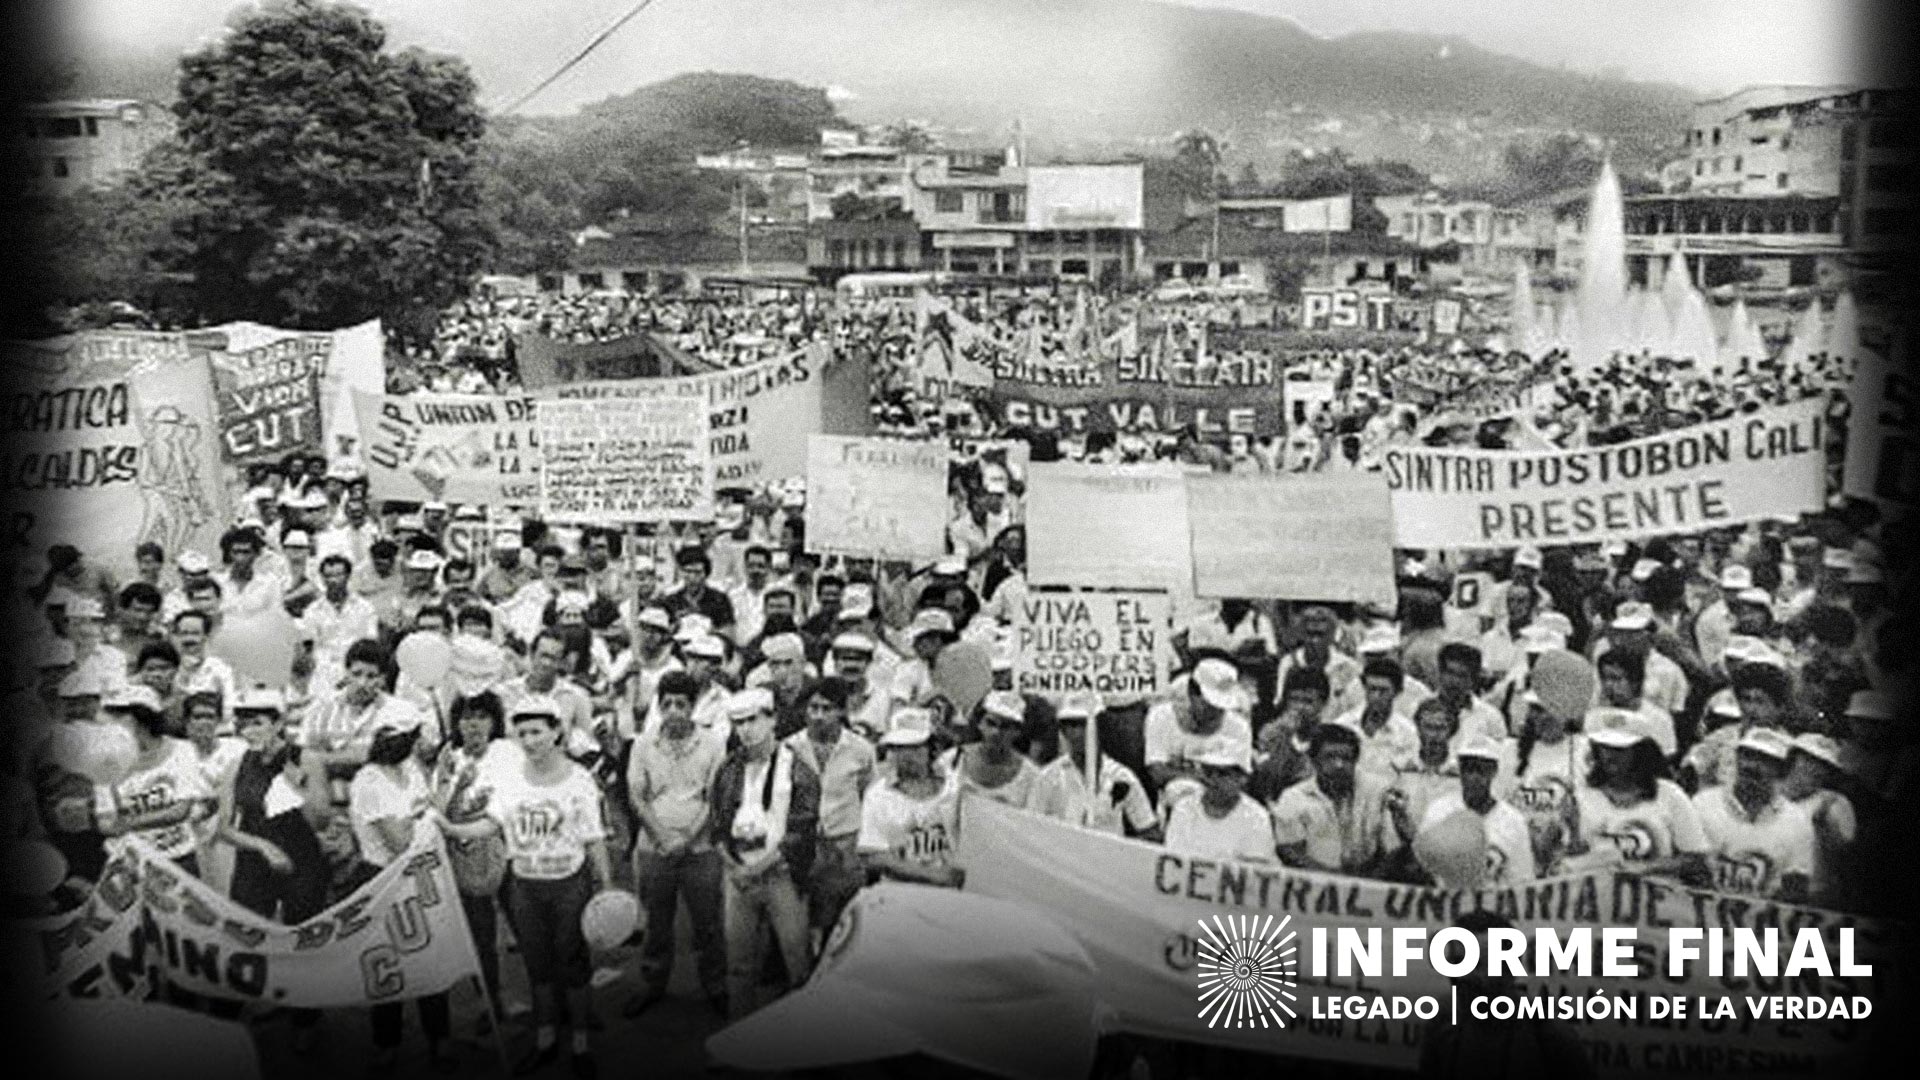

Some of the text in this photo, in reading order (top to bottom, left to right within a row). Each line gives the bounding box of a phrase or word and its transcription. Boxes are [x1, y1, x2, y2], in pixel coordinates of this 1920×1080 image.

[1302, 295, 1392, 330] PST
[226, 406, 311, 453] CUT
[1007, 402, 1255, 433] CUT VALLE
[1386, 450, 1494, 492] SINTRA
[1480, 480, 1729, 538] PRESENTE
[1022, 599, 1151, 625] VIVA EL
[1120, 627, 1154, 653] EN
[1153, 852, 1374, 918] CENTRAL
[1610, 872, 1673, 930] DE
